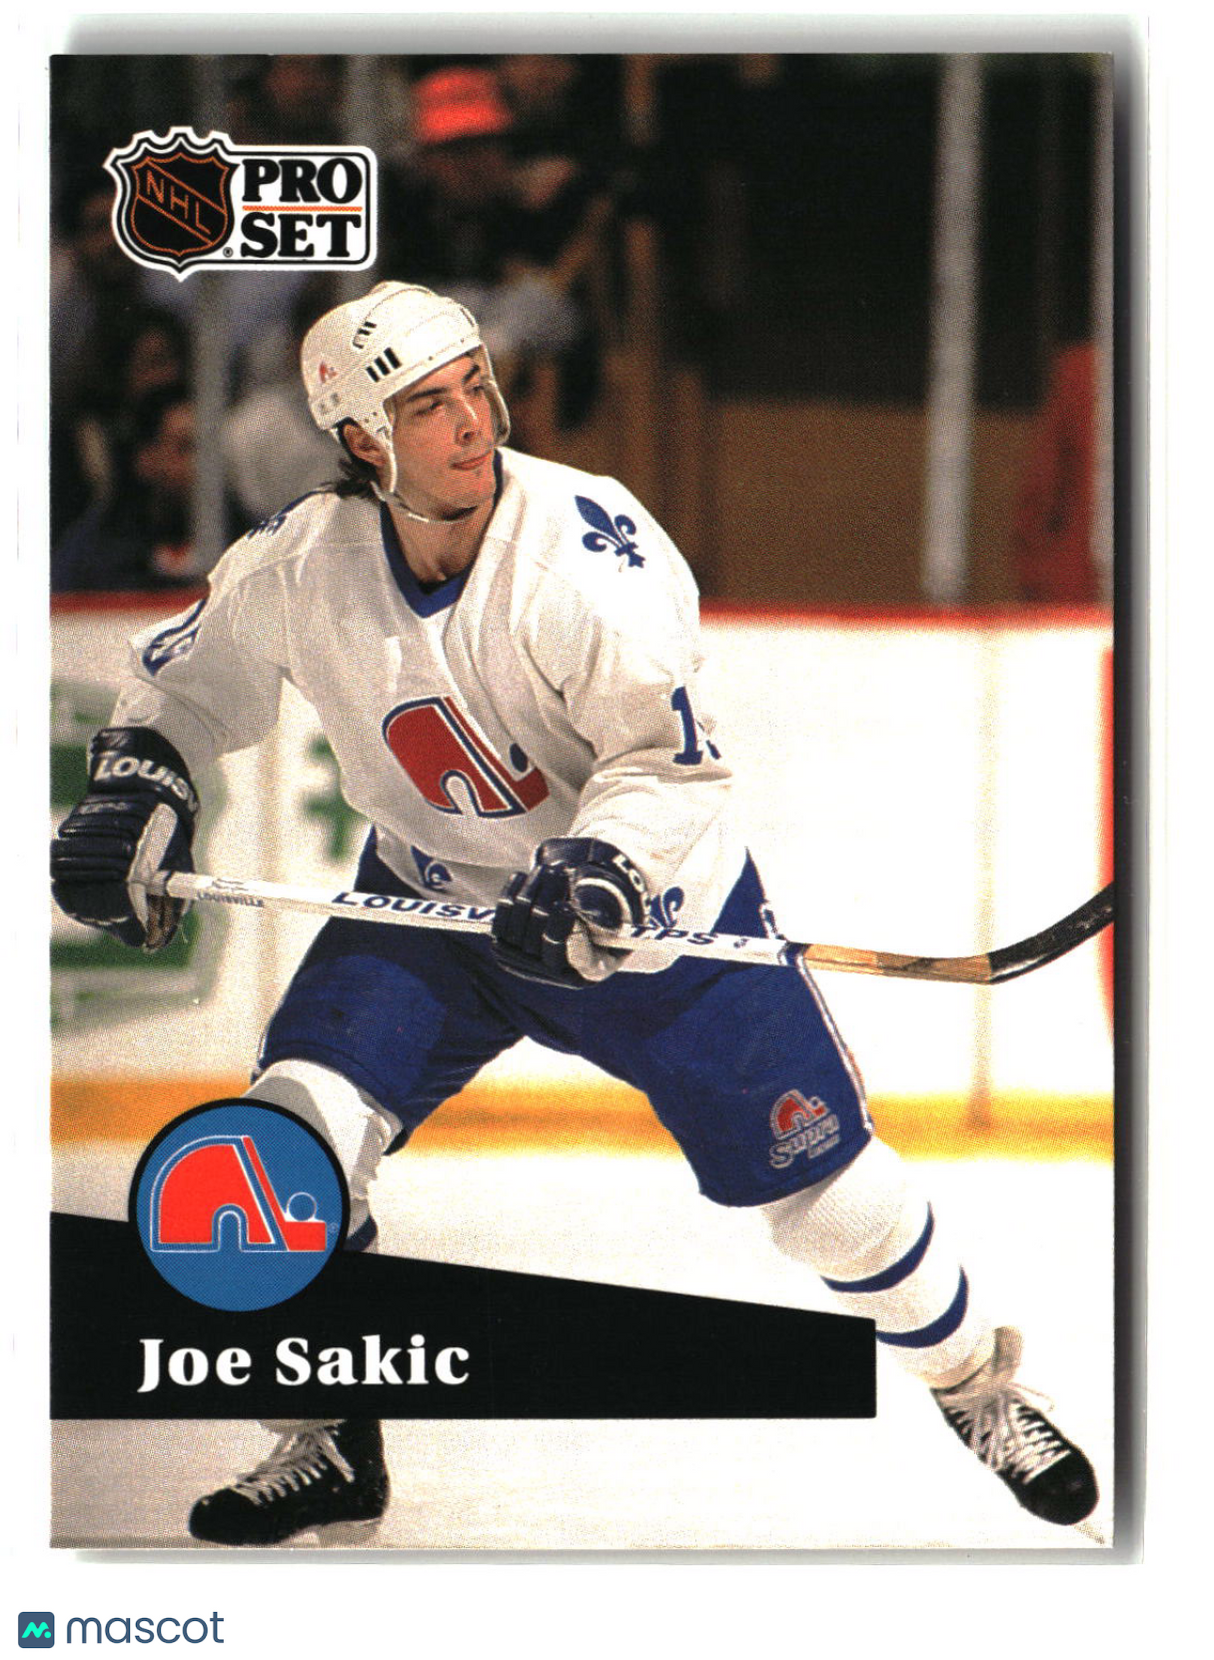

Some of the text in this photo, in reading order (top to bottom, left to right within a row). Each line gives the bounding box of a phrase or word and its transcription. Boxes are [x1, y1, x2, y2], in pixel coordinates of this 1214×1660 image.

[146, 168, 212, 235] NHL
[241, 157, 362, 204] PRO
[240, 212, 362, 258] SET
[671, 686, 721, 763] 1
[137, 1333, 471, 1393] Joe Sakic
